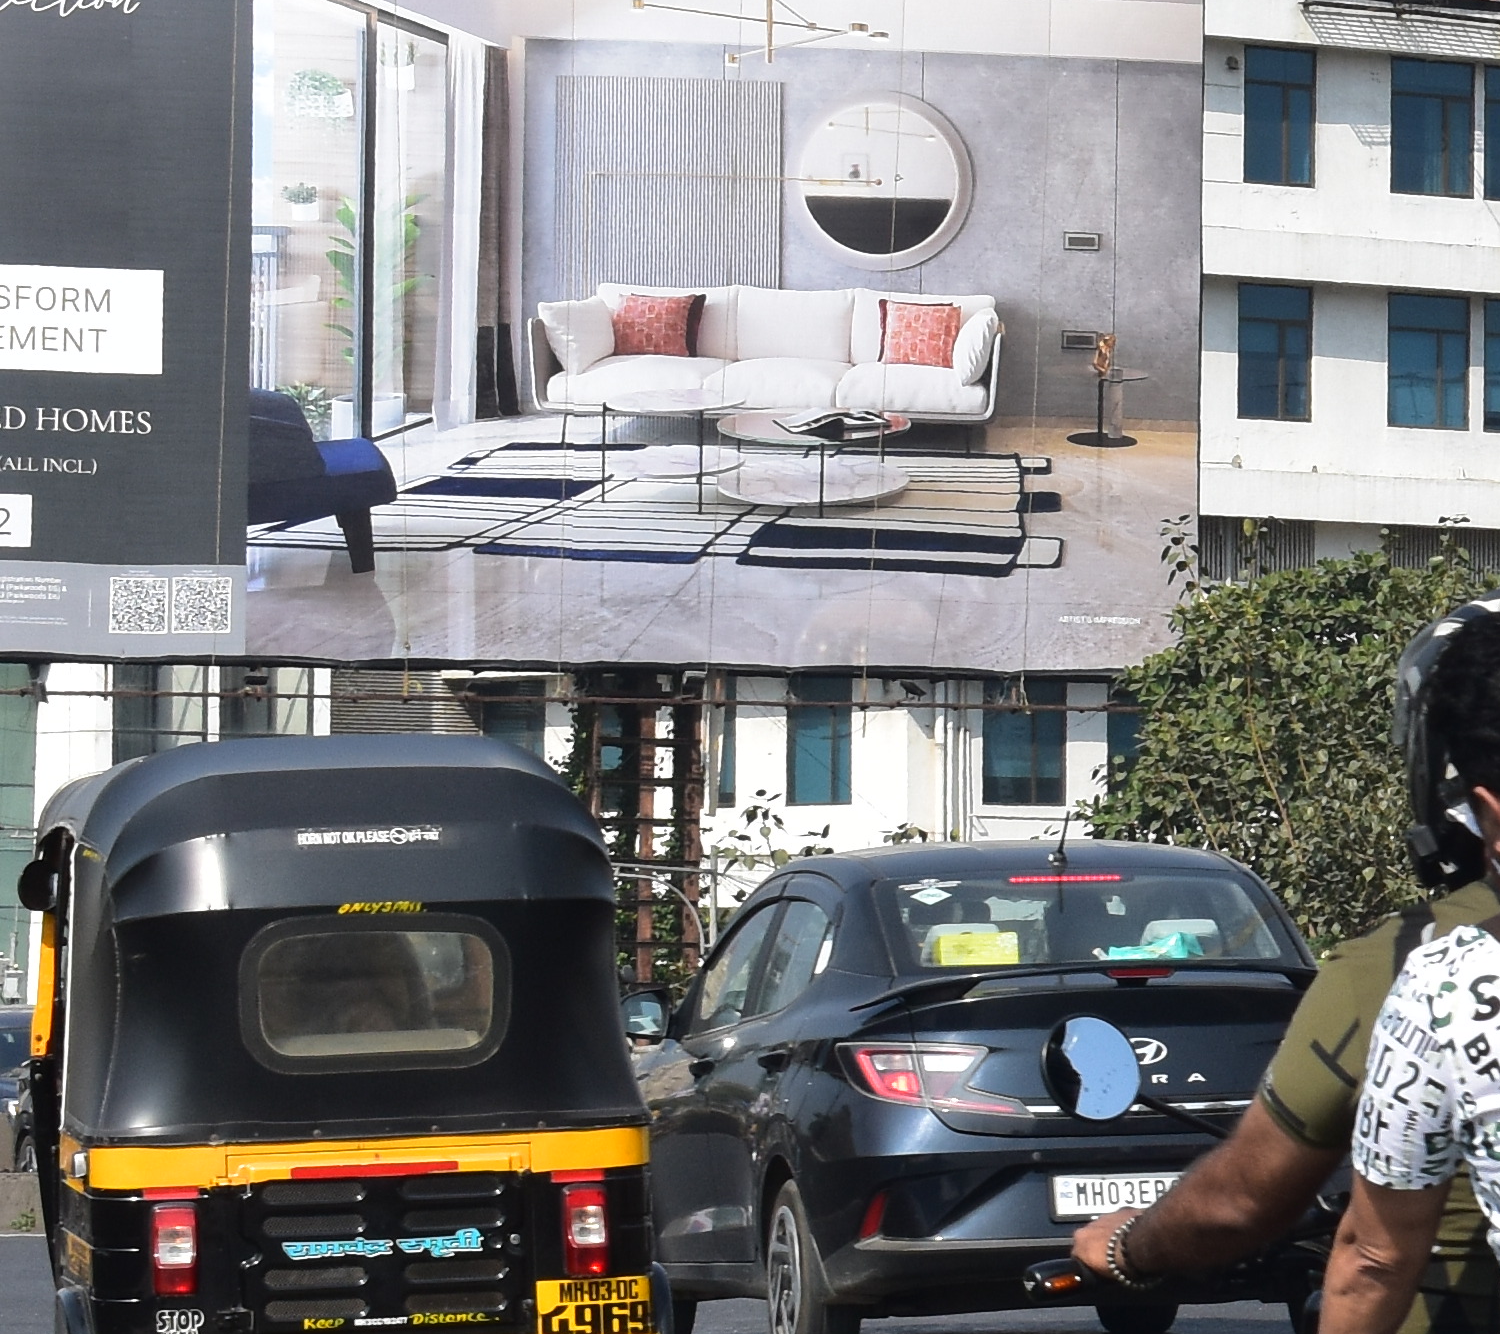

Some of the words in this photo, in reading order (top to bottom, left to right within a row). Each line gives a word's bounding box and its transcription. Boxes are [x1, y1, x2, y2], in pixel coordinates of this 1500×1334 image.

[0, 325, 107, 353] MENT
[35, 406, 153, 434] HOMES
[1075, 1179, 1178, 1207] MH03EB
[156, 1309, 205, 1332] STOP
